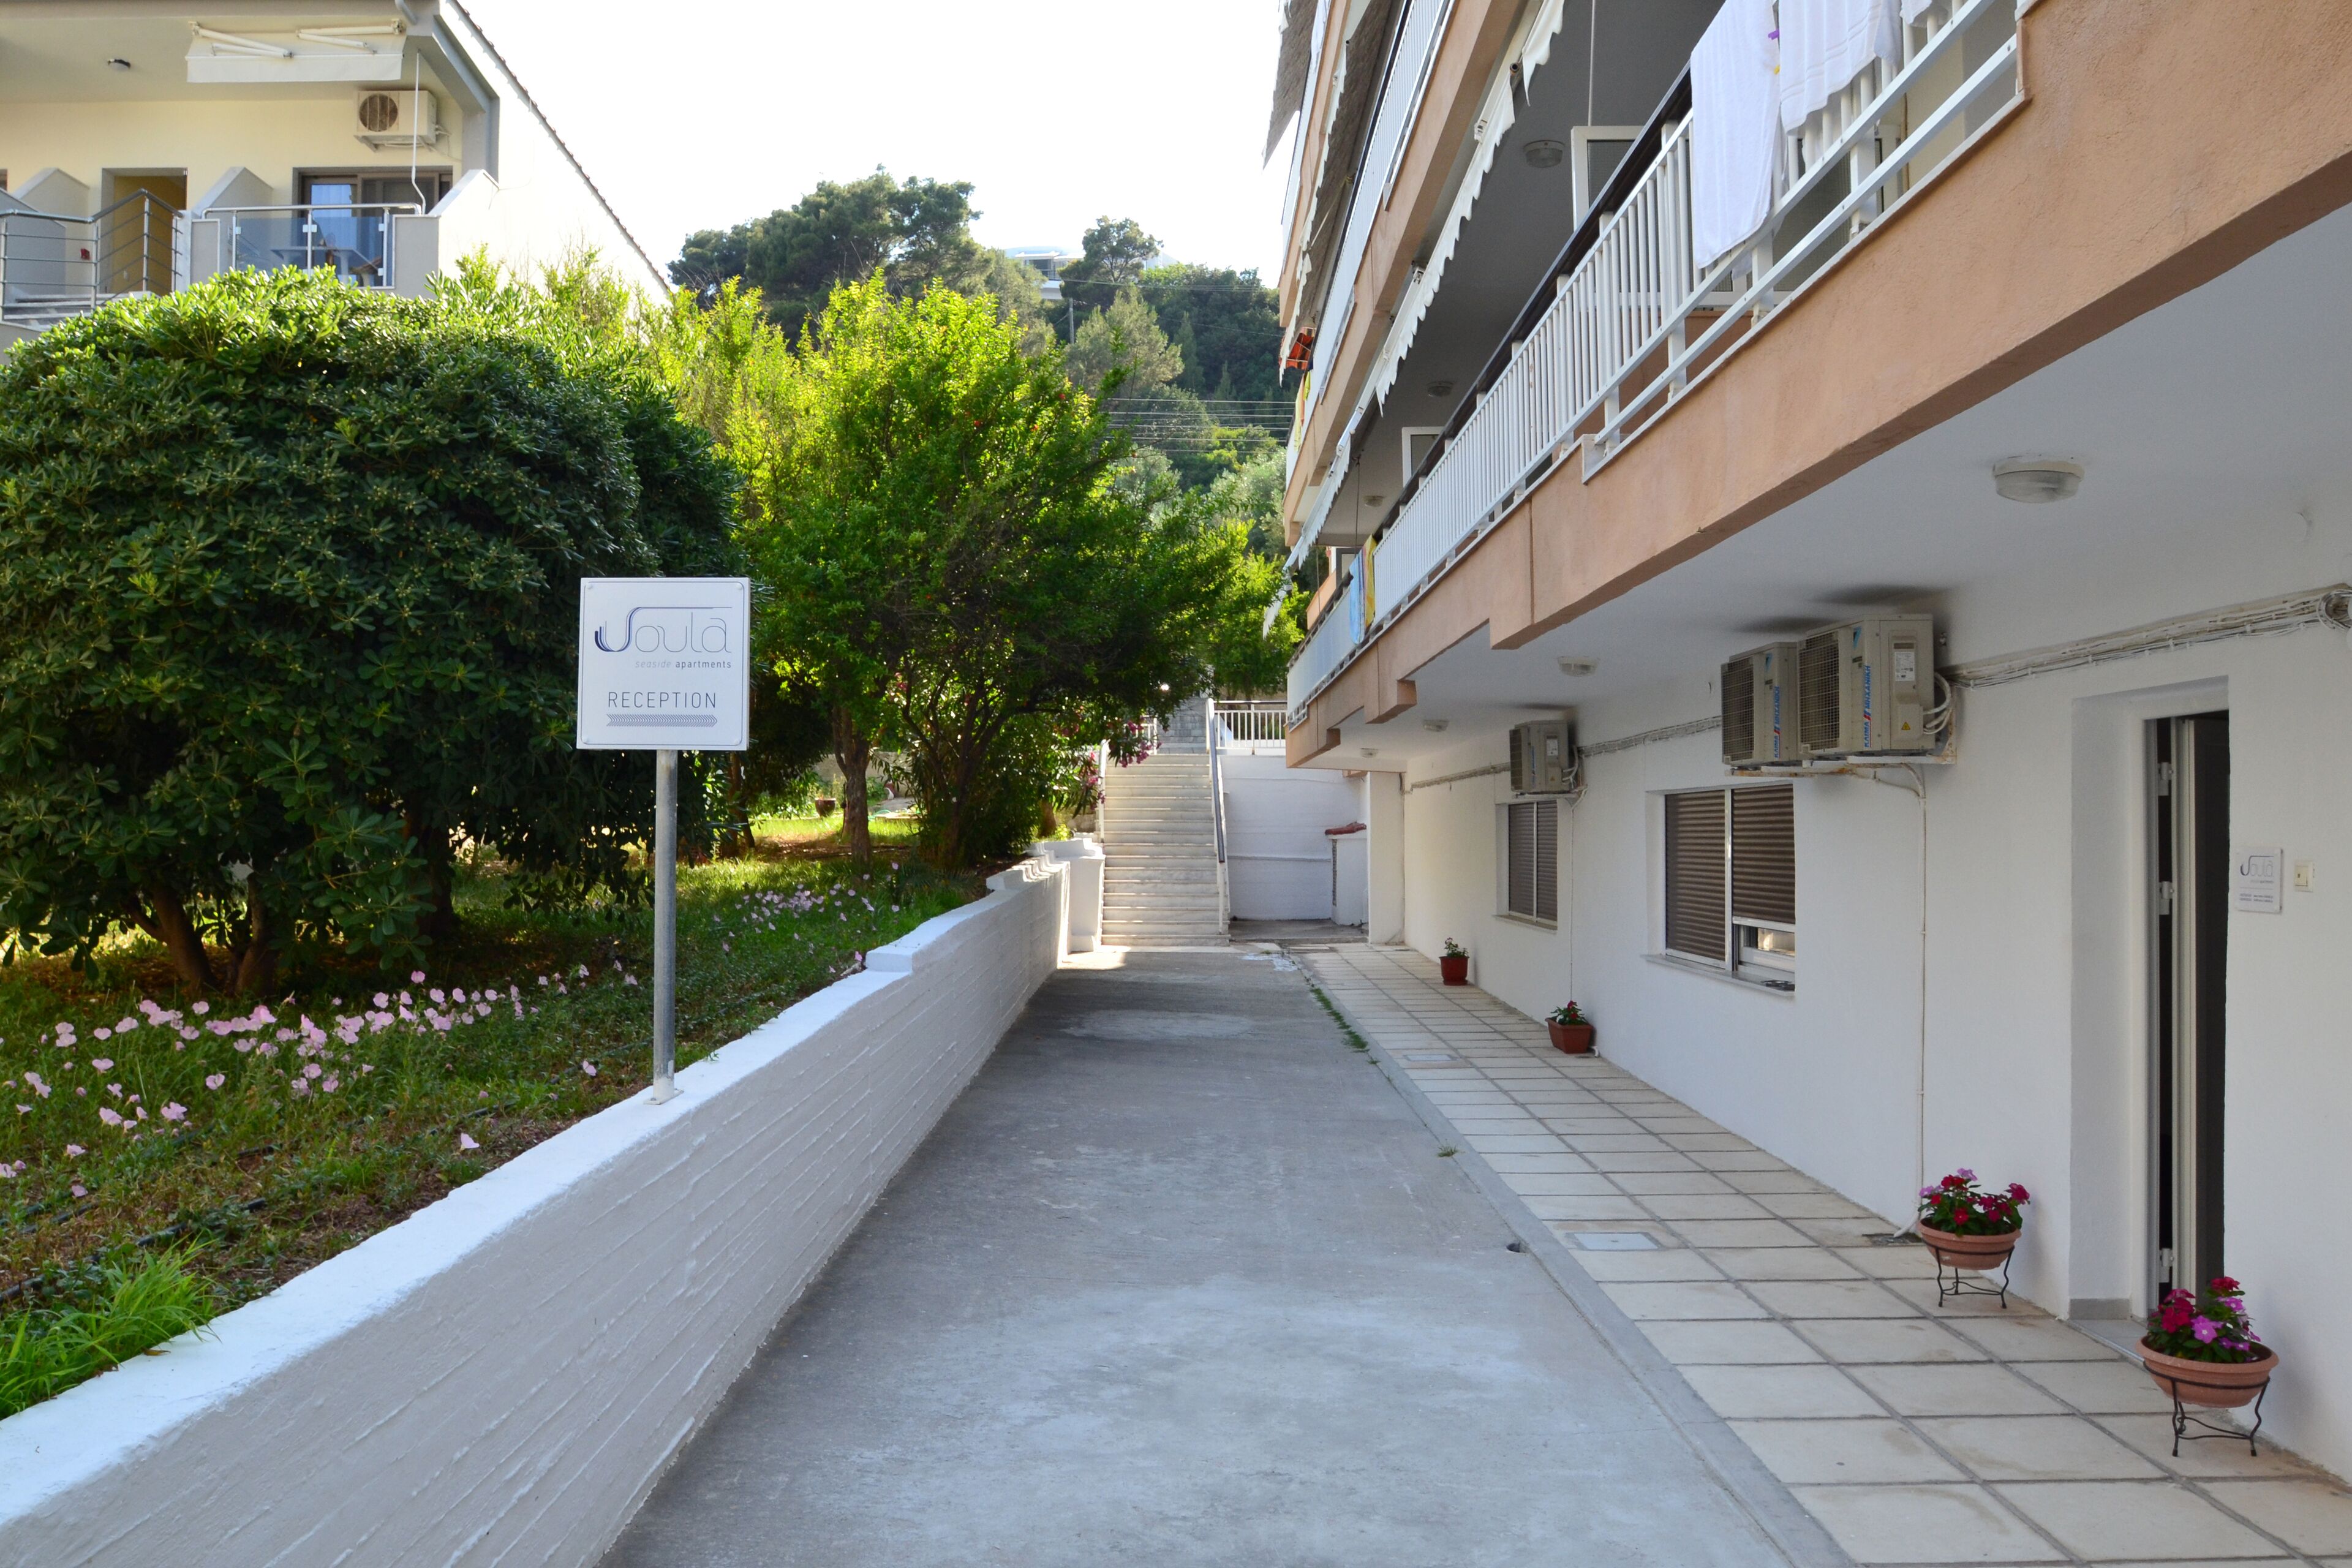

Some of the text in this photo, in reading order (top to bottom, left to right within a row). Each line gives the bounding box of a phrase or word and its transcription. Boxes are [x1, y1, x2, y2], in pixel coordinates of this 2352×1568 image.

[594, 606, 733, 653] Soula
[635, 659, 731, 669] seaside apartments
[608, 692, 716, 708] RECEPTION
